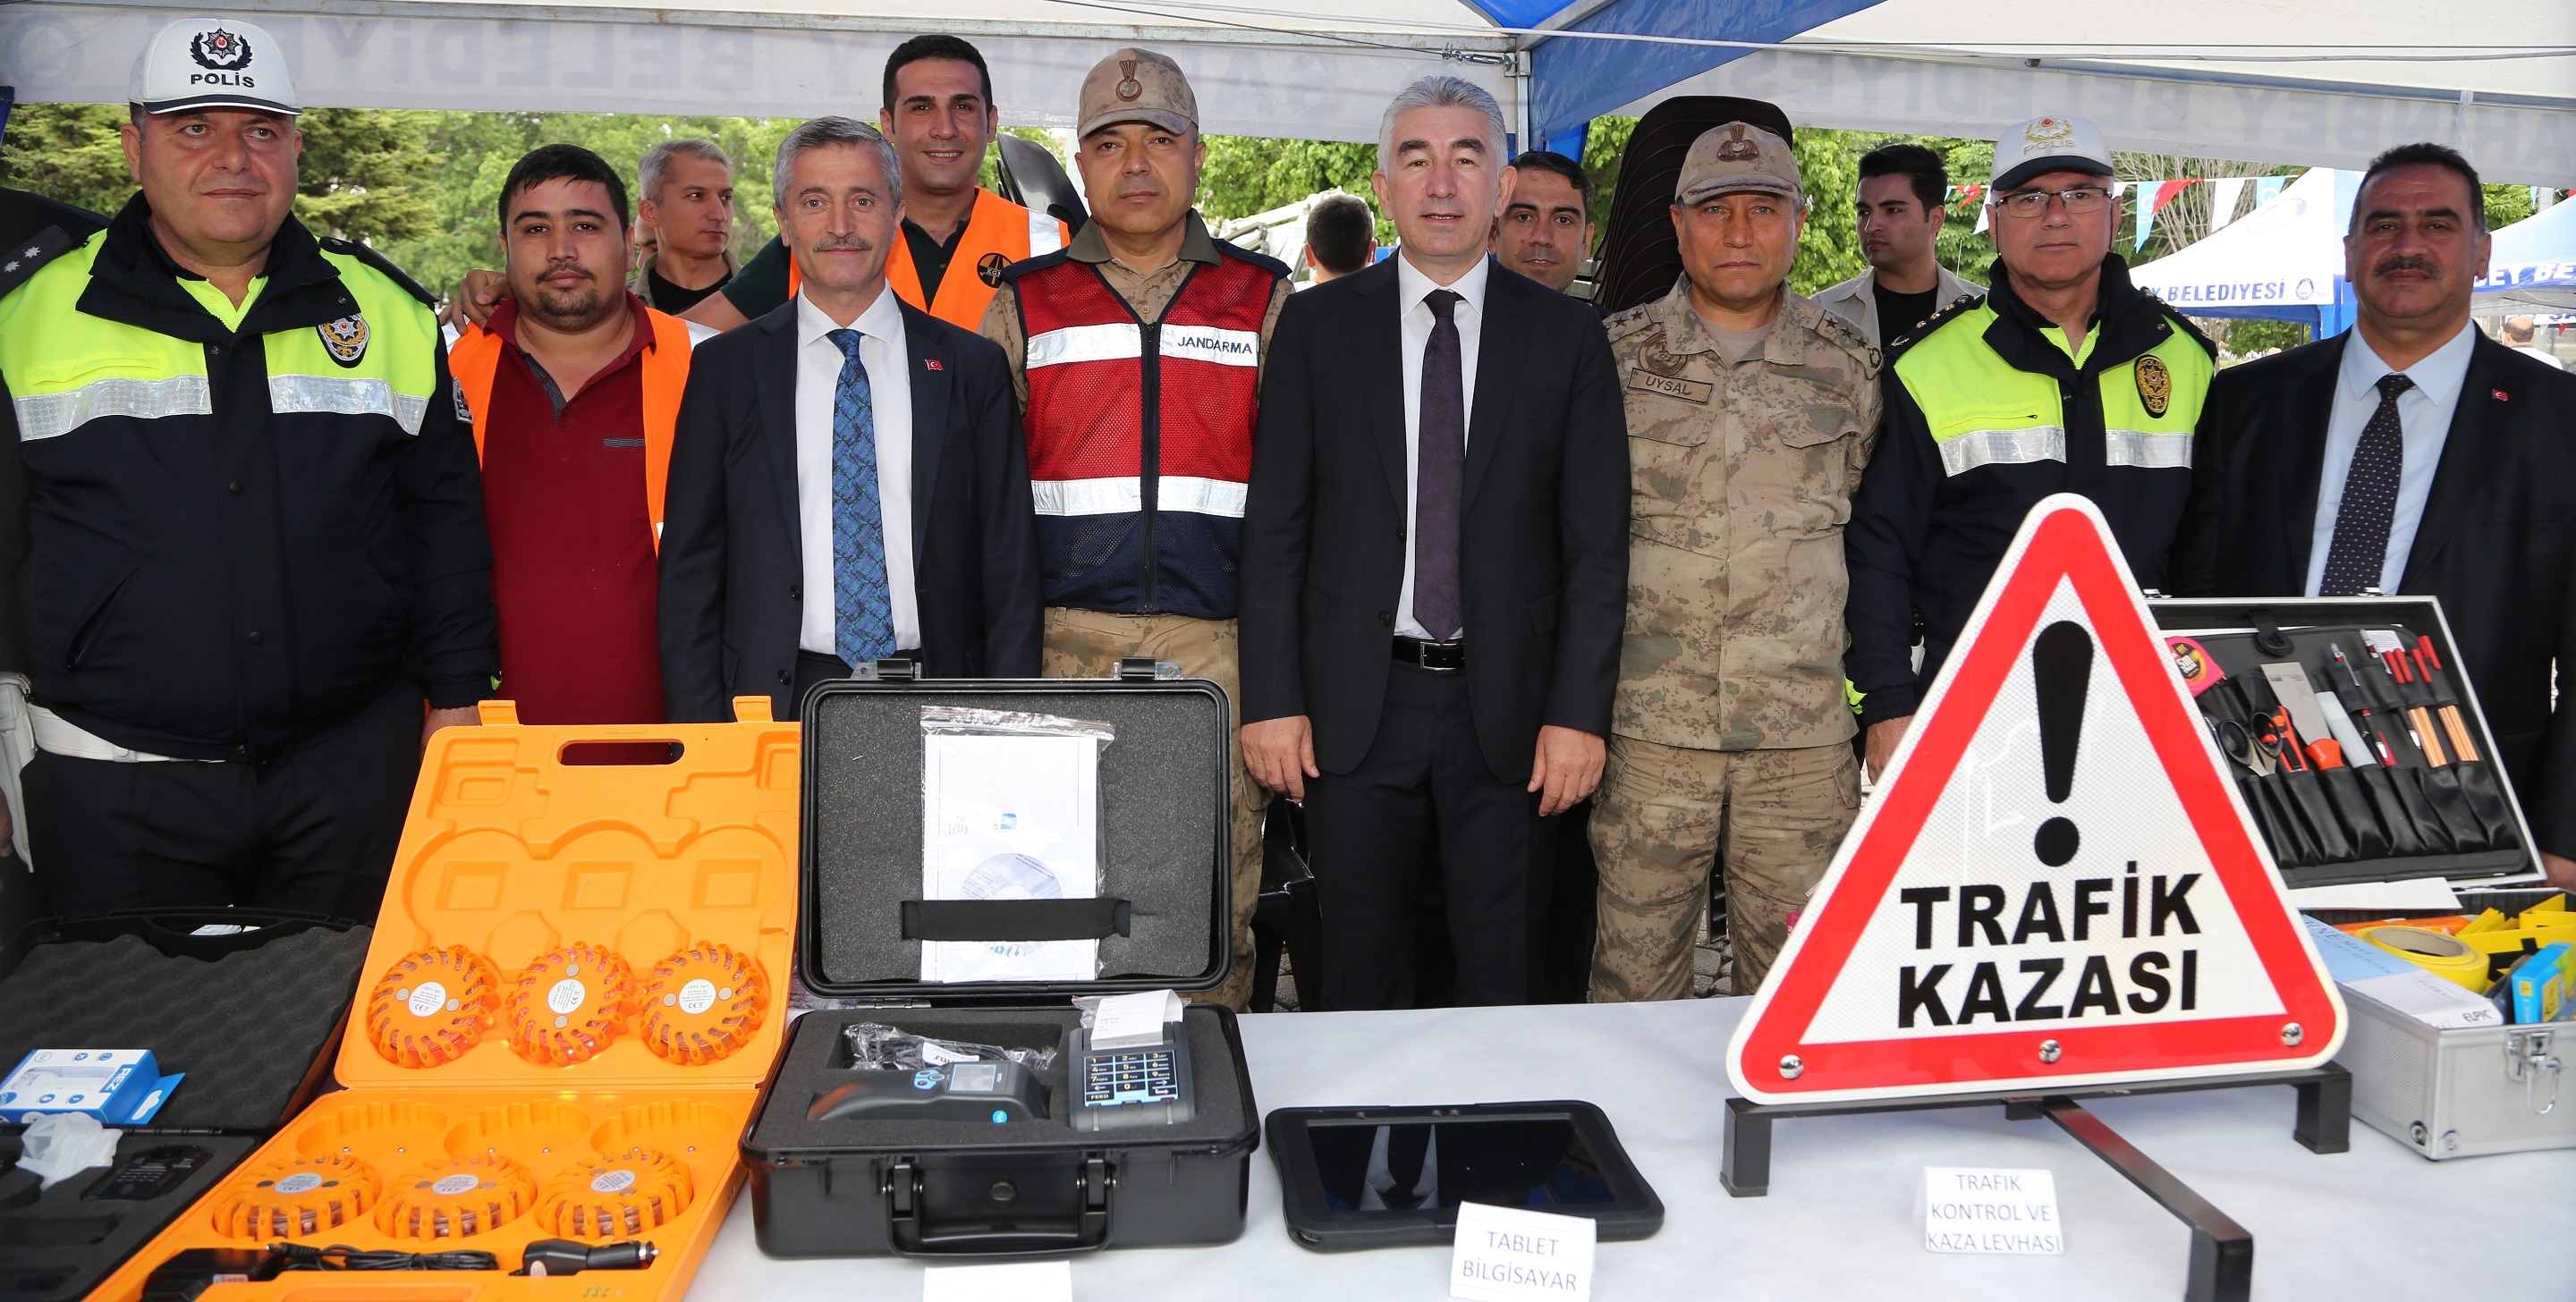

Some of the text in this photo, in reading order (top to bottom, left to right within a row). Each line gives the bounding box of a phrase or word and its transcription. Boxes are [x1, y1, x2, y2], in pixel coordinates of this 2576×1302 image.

[191, 72, 255, 88] POLİS
[2167, 278, 2285, 302] BELEDİYESİ
[1177, 336, 1252, 354] JANDARMA
[1646, 376, 1690, 394] UYSAL
[1900, 860, 2203, 950] TRAFİK
[1898, 949, 2198, 1028] KAZASI
[1955, 1174, 2021, 1191] TRAFIK
[1931, 1204, 2052, 1222] KONTROL VE
[1487, 1230, 1560, 1256] TABLET
[1928, 1233, 2061, 1252] KAZA LEVHASI
[1462, 1257, 1577, 1291] BİLGİSAYAR
